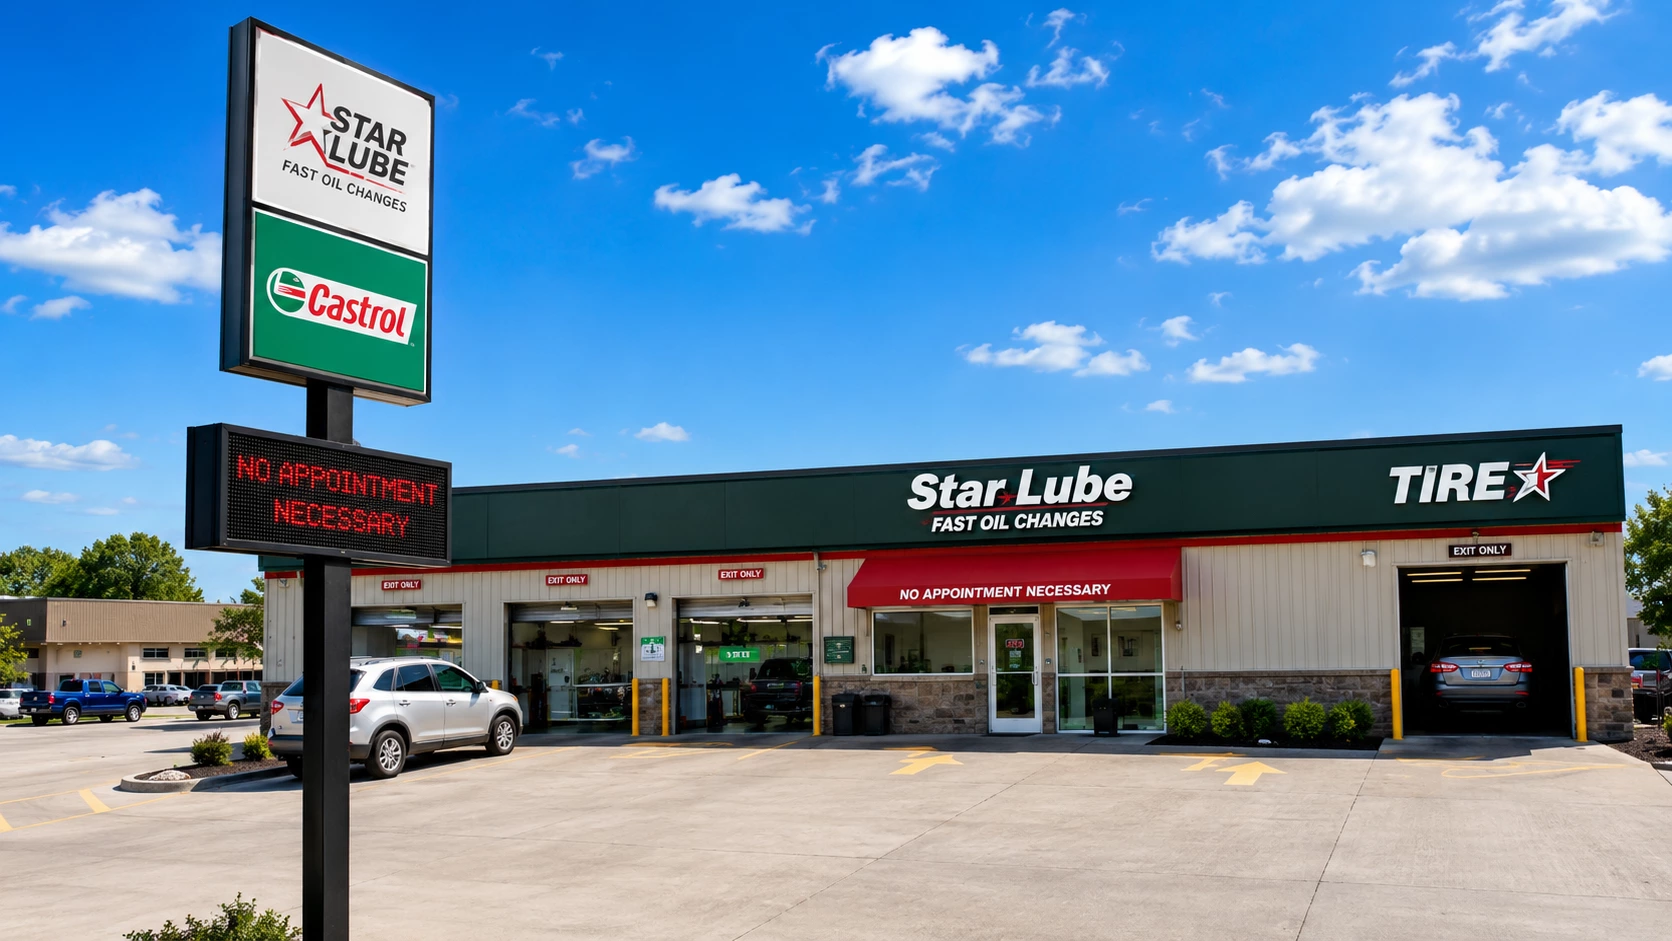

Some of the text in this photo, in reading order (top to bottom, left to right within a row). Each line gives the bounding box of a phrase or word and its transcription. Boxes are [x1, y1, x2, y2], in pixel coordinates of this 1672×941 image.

[330, 106, 407, 156] STAR
[328, 134, 409, 186] LUBE
[282, 159, 407, 213] FAST OIL CHANGES
[308, 283, 406, 337] Castrol
[237, 454, 438, 506] NO APPOINTMENT
[907, 465, 1133, 511] Star Lube
[1389, 461, 1510, 504] TIRE
[273, 498, 409, 538] NECESSARY
[931, 510, 1104, 532] FAST OIL CHANGES
[1453, 545, 1507, 556] EXIT ONLY
[547, 575, 586, 584] EXIT ONLY
[720, 569, 762, 579] EXIT ONLY
[899, 583, 1111, 600] NO APPOINTMENT NECESSARY
